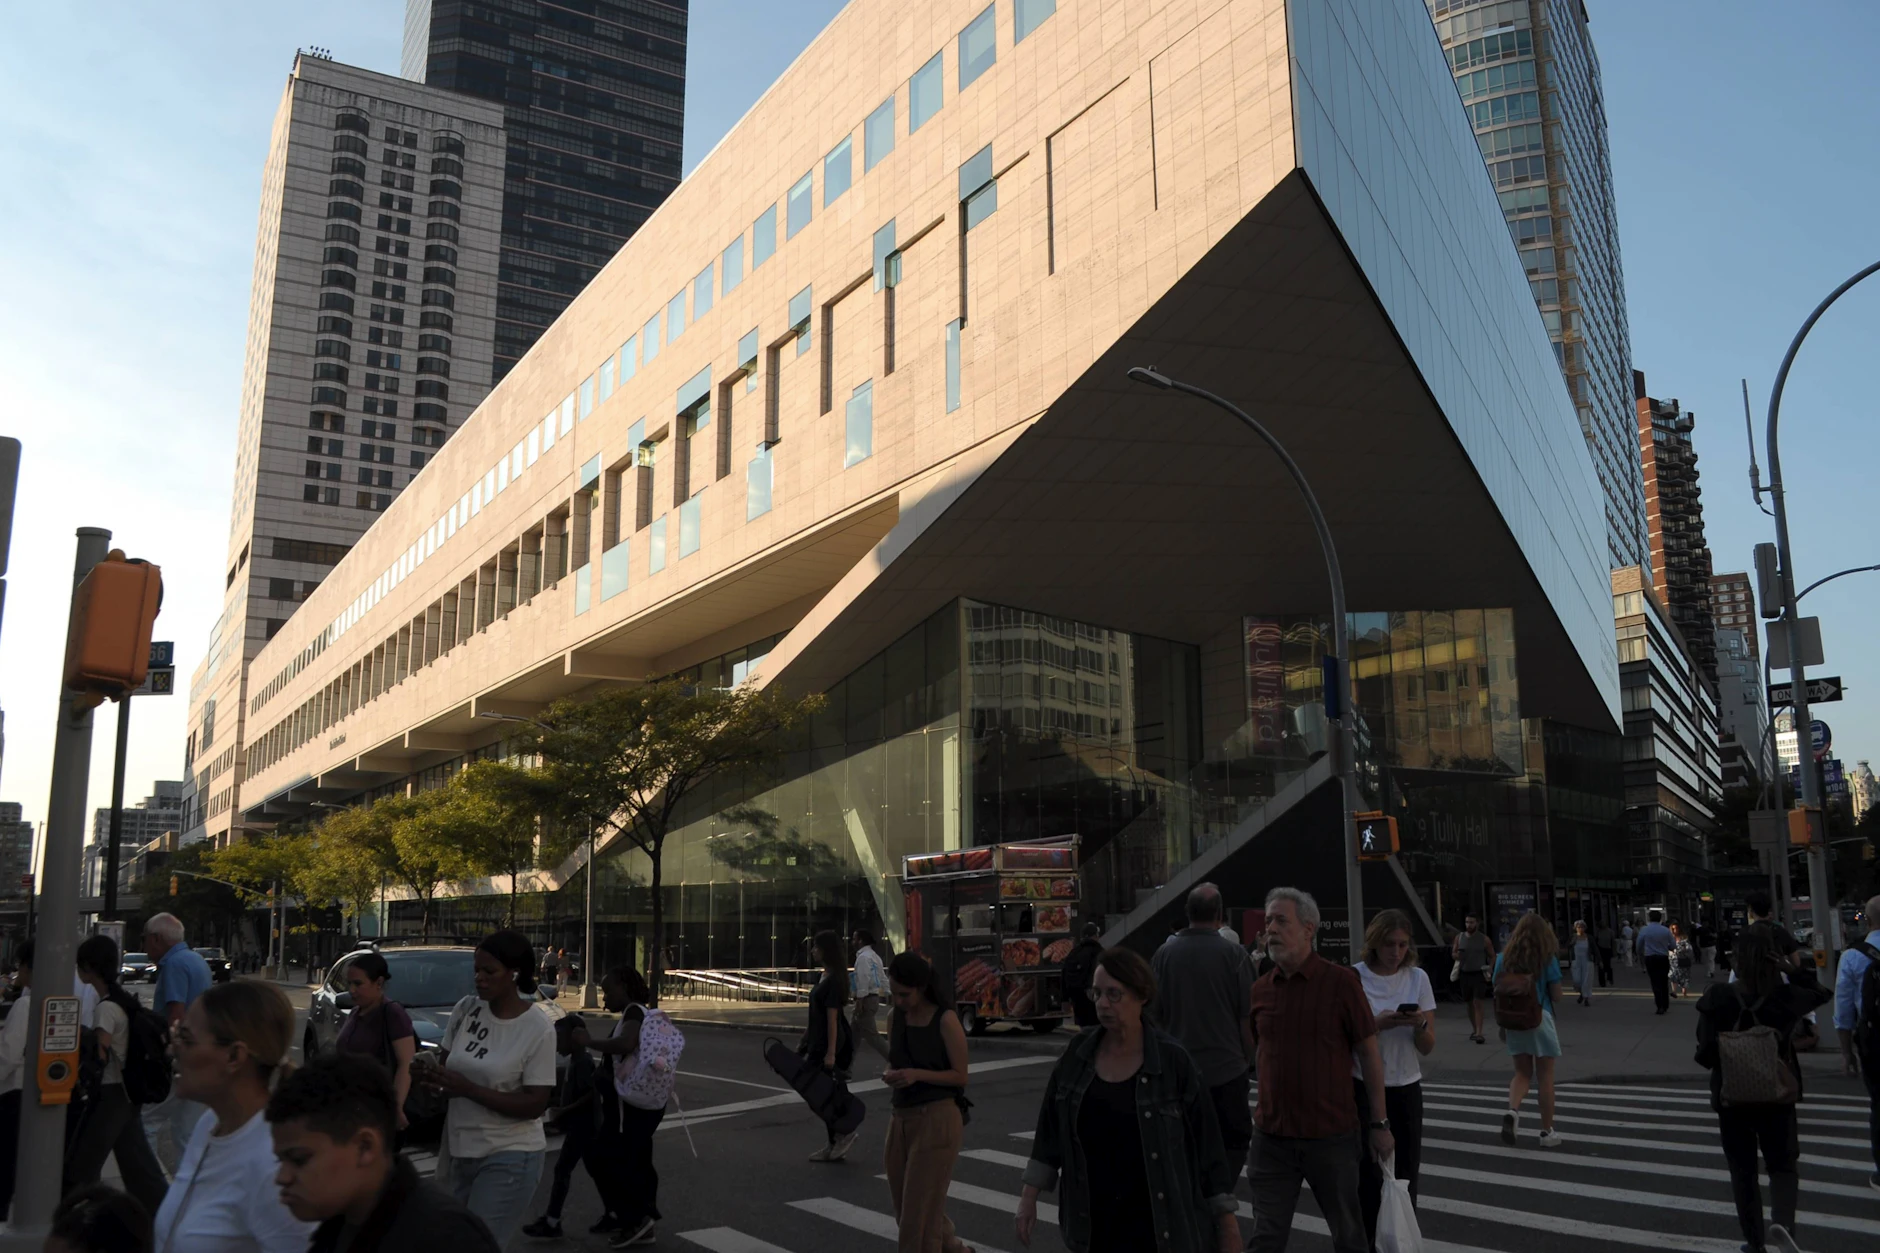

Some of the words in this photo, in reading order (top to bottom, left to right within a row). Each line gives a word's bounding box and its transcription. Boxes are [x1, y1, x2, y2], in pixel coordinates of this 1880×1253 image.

[1777, 689, 1792, 700] ON
[1807, 685, 1830, 697] WAY
[1824, 772, 1835, 782] M5
[1429, 811, 1461, 850] Tully
[1465, 816, 1489, 845] Hall
[468, 1006, 482, 1019] A
